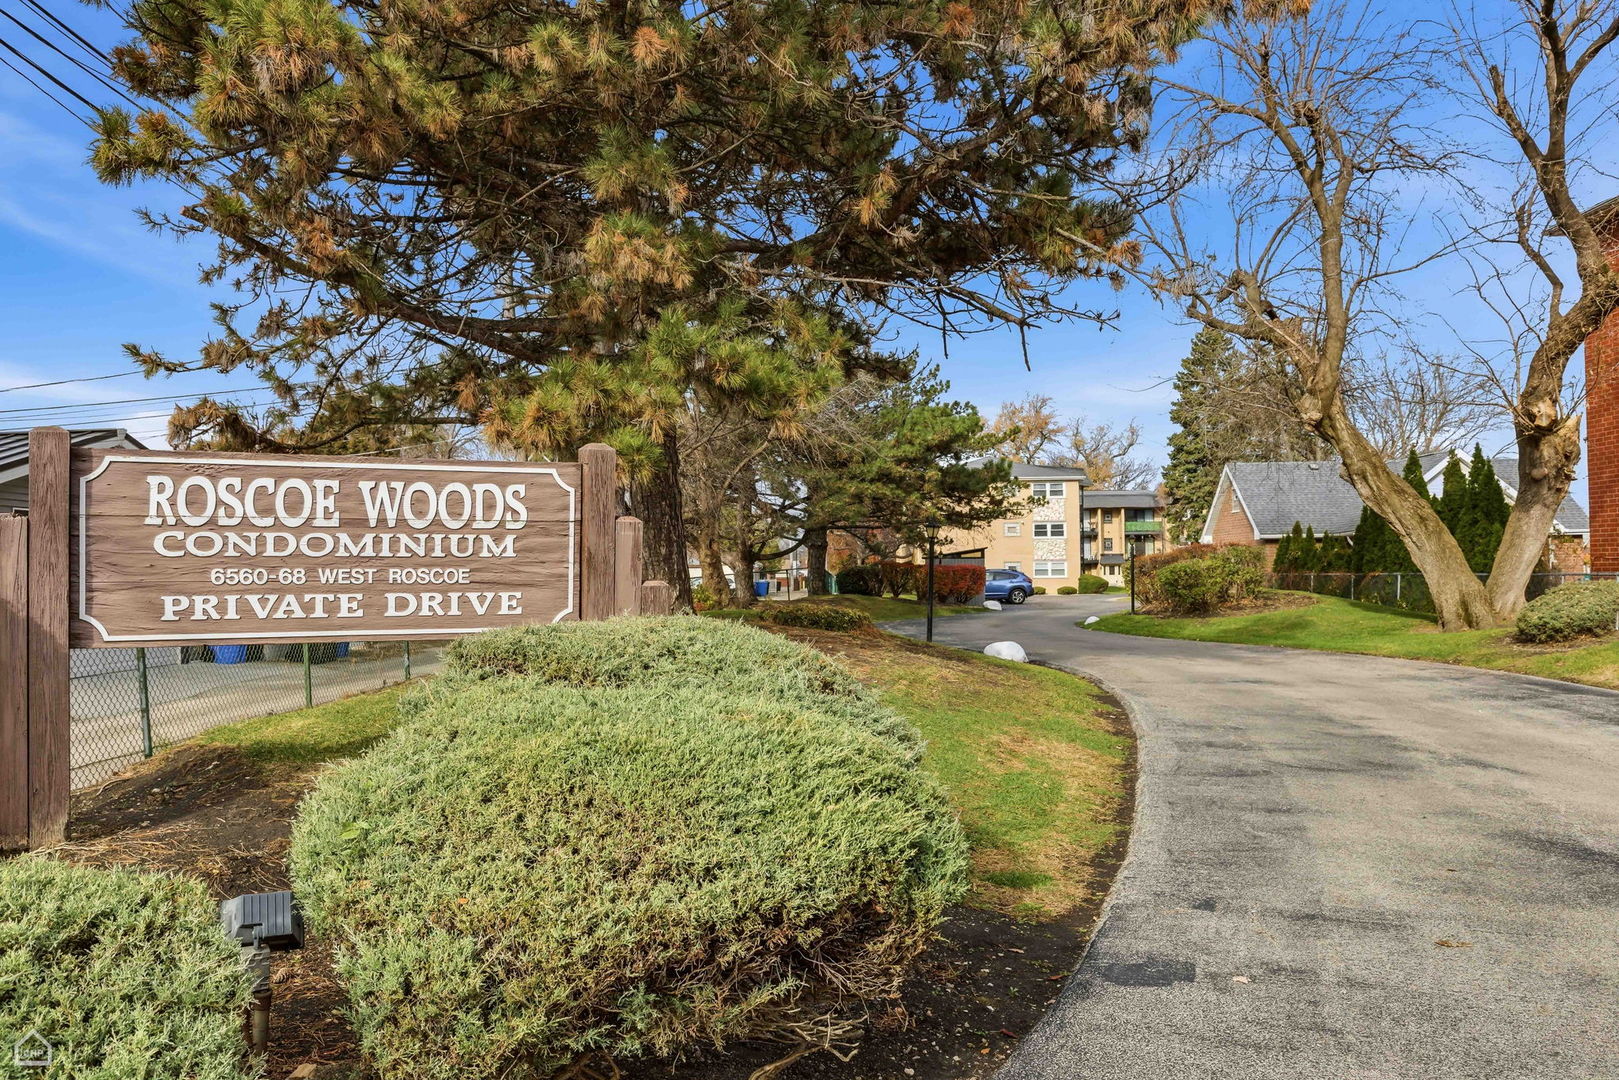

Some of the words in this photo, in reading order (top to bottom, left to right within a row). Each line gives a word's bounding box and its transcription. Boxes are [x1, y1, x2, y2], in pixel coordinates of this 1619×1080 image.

[145, 475, 340, 528] ROSCOE
[360, 480, 528, 530] WOODS
[153, 531, 517, 558] CONDOMINIUM
[210, 568, 306, 585] 6560-68
[317, 568, 377, 585] WEST
[388, 568, 471, 585] ROSCOE
[161, 593, 364, 621] PRIVATE
[384, 592, 523, 618] DRIVE
